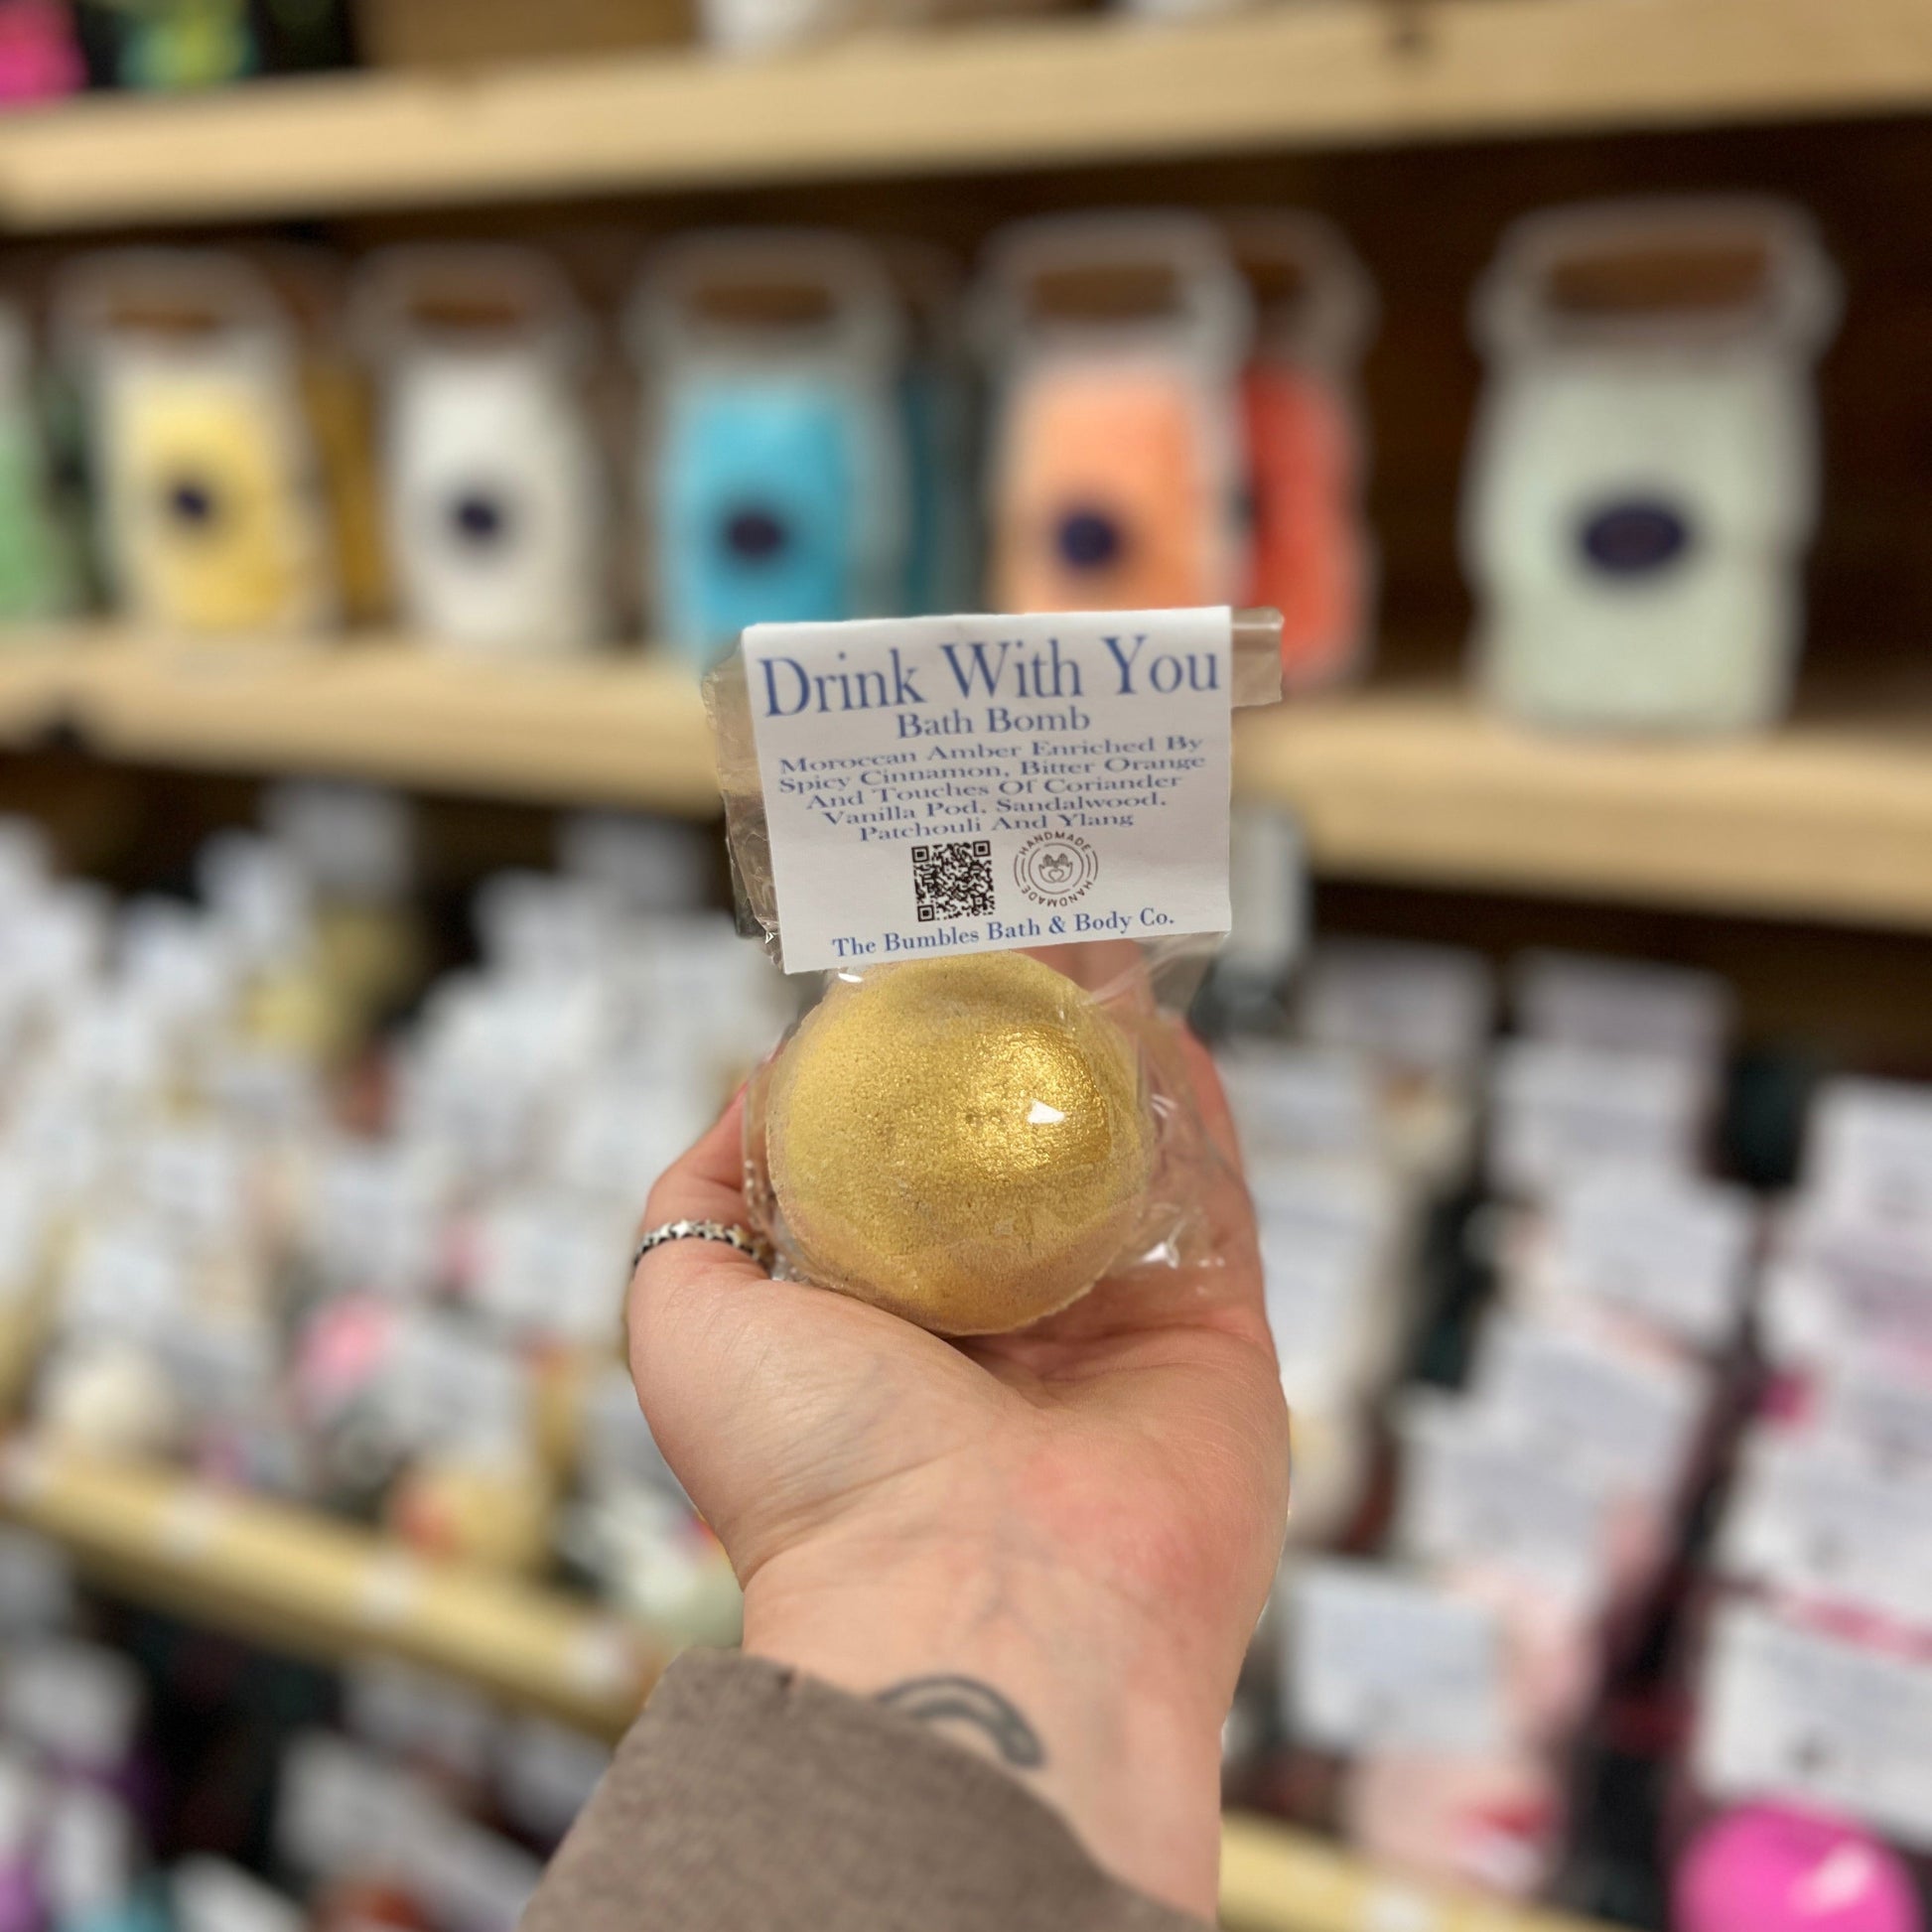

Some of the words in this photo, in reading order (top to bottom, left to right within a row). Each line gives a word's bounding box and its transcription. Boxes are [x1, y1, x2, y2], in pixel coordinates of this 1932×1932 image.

[758, 647, 928, 718] Drink
[939, 637, 1083, 700] With
[1101, 634, 1221, 694] You
[897, 708, 974, 740] Bath
[987, 705, 1091, 734] Bomb
[779, 752, 917, 773] Moroccan
[927, 744, 1022, 761] Amber
[1032, 737, 1155, 757] Enriched
[1167, 736, 1204, 753] By
[779, 775, 851, 794] Spicy
[1021, 760, 1096, 776] Bitter
[1104, 757, 1206, 772] Orange
[806, 790, 865, 810] And
[872, 782, 990, 802] Touches
[999, 778, 1038, 795] Of
[1044, 774, 1183, 793] Coriander
[823, 806, 916, 826] Vanilla
[860, 817, 982, 842] Patchouli
[992, 815, 1048, 831] And
[1058, 813, 1135, 827] Ylang
[1019, 831, 1091, 855] HANDMADE
[1021, 881, 1093, 907] HANDMADE
[832, 937, 877, 957] The
[883, 926, 980, 952] Bumbles
[987, 917, 1040, 941] Bath
[1048, 915, 1066, 933] &
[1074, 910, 1133, 934] Body
[1140, 907, 1174, 926] Co.
